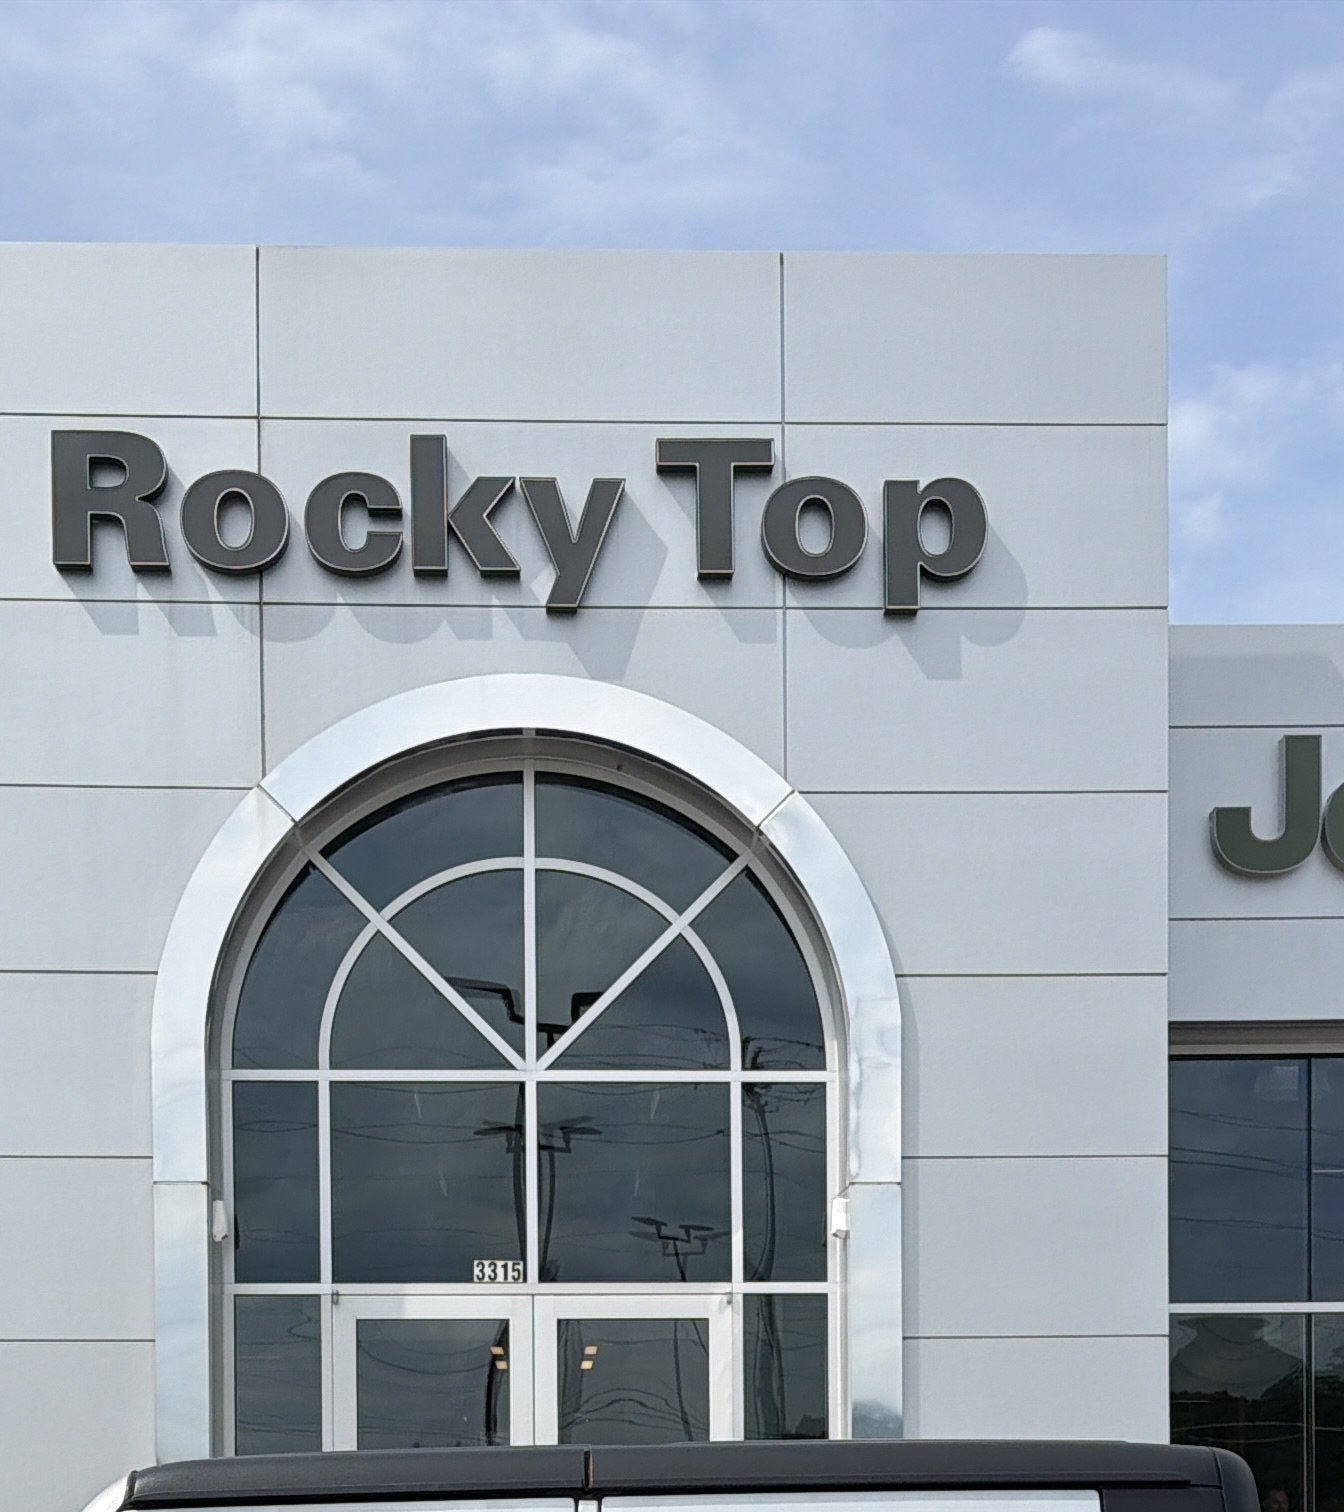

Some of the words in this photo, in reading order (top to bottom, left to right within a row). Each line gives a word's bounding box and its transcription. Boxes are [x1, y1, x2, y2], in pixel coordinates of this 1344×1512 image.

[52, 430, 626, 611] Rocky
[656, 437, 989, 613] Top
[476, 1261, 522, 1281] 3315
